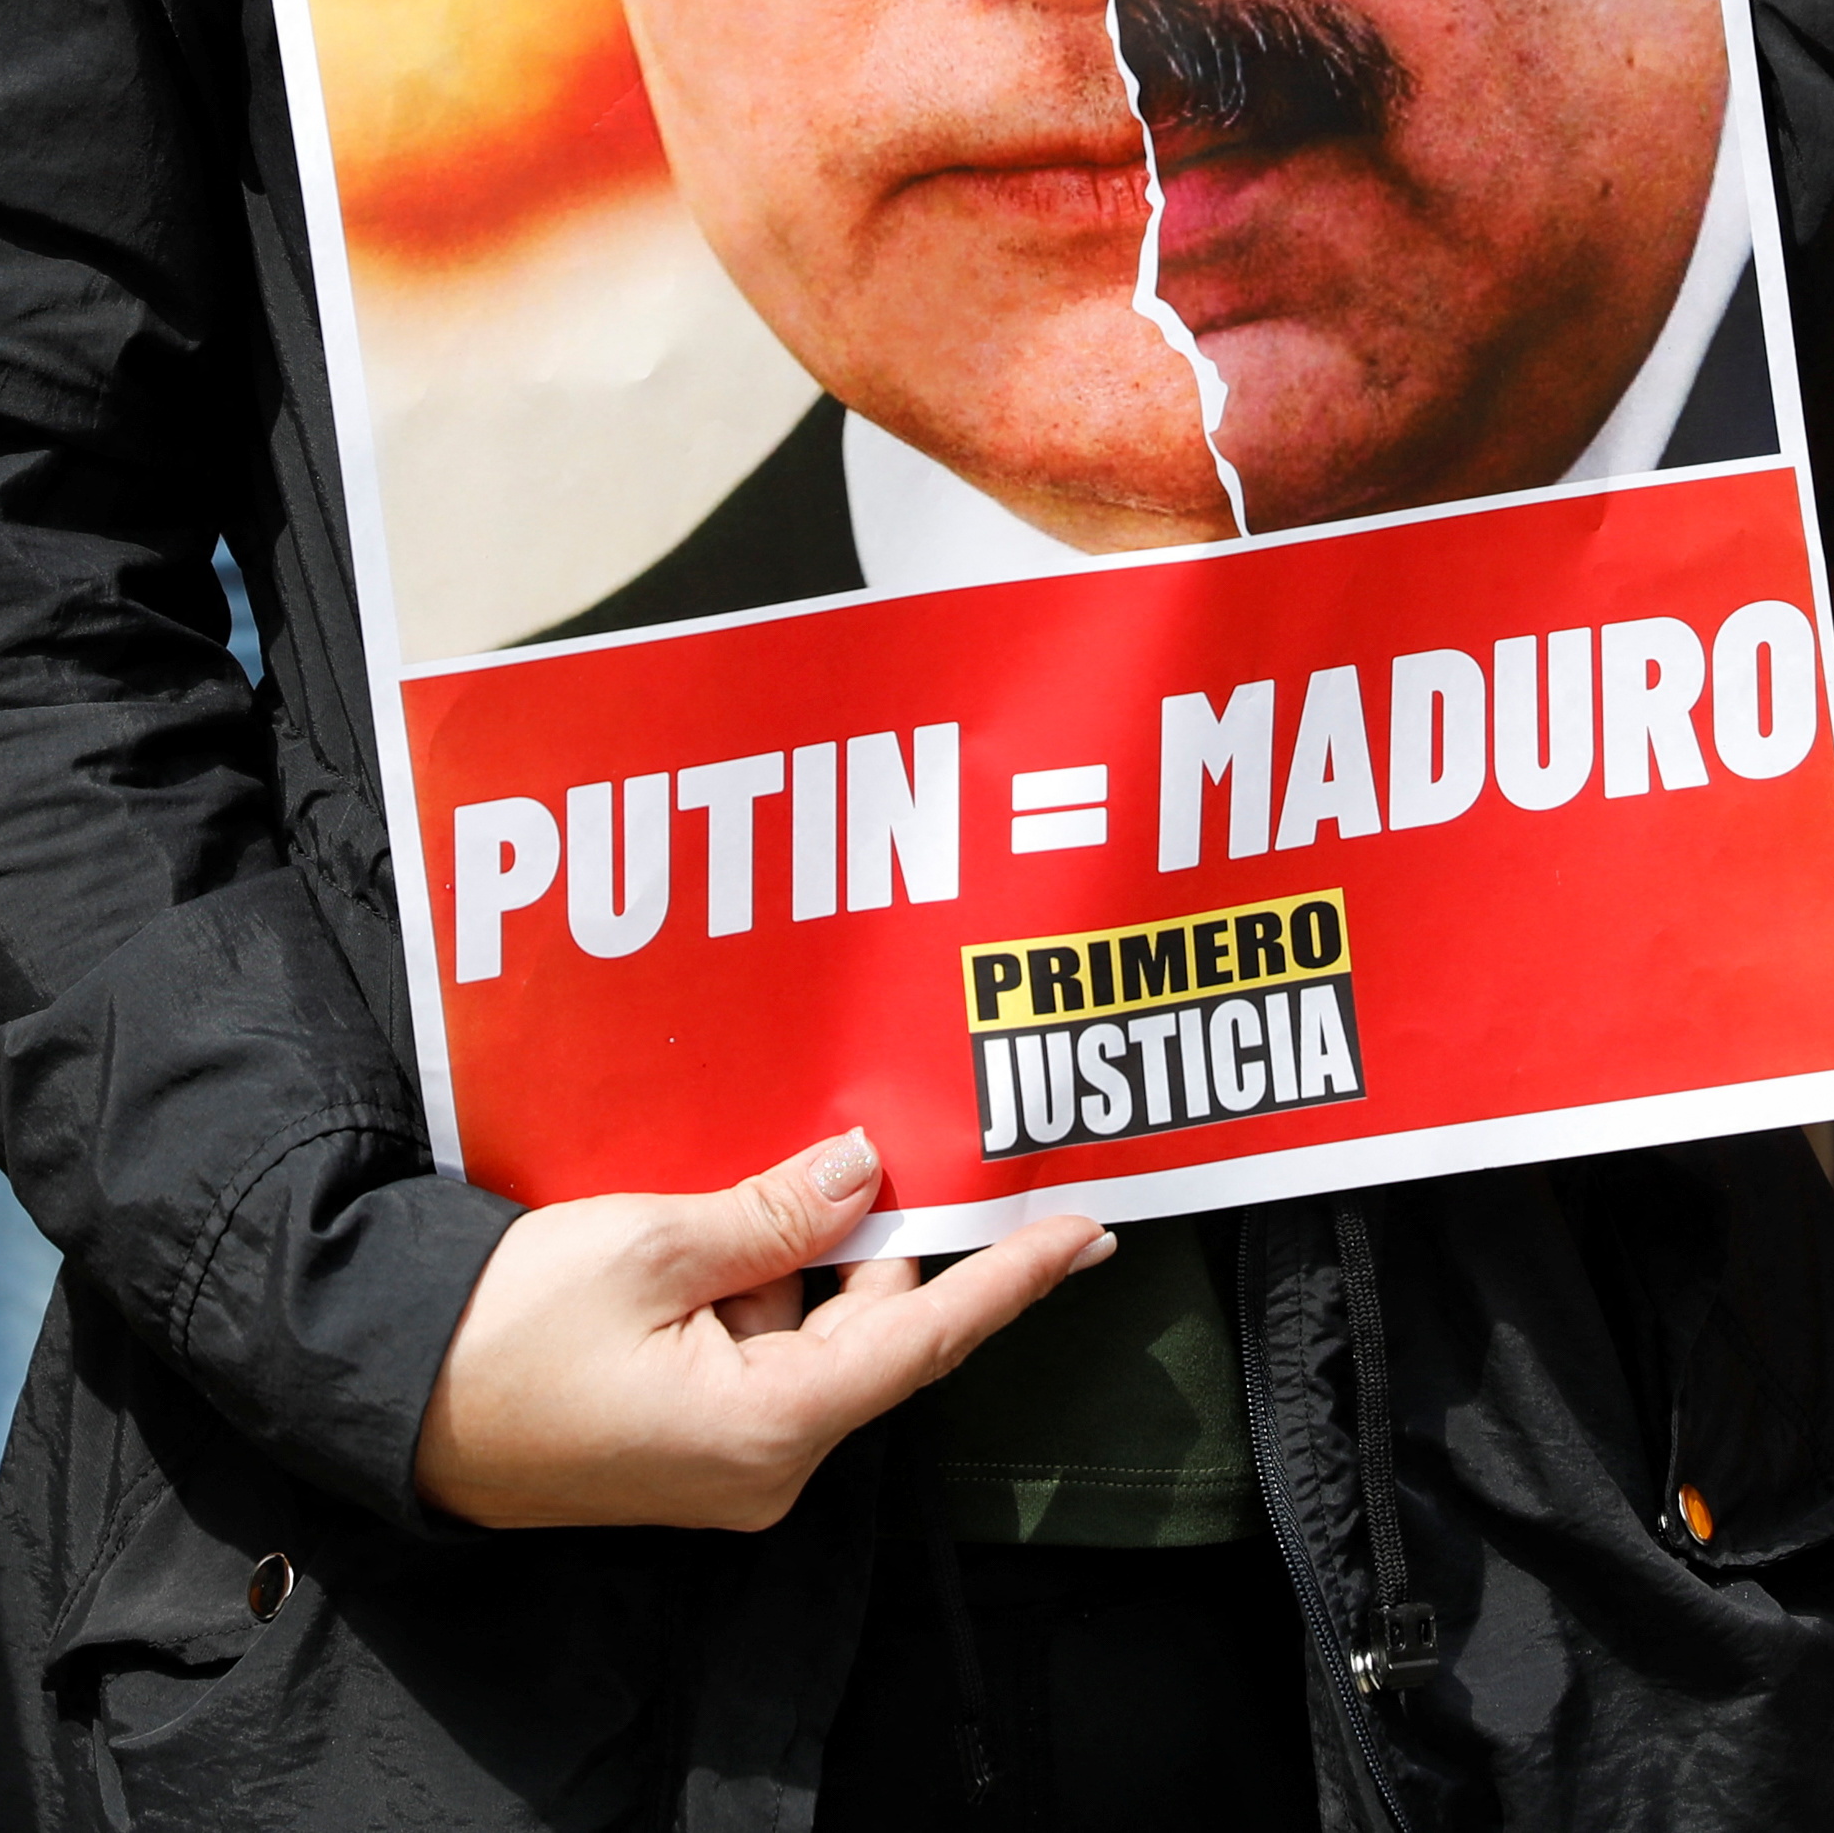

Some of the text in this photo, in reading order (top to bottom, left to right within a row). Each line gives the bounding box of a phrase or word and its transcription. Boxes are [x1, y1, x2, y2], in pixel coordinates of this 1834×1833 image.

[454, 599, 1818, 984] PUTIN = MADURO
[971, 898, 1343, 1022] PRIMERO
[981, 984, 1360, 1154] JUSTICIA
